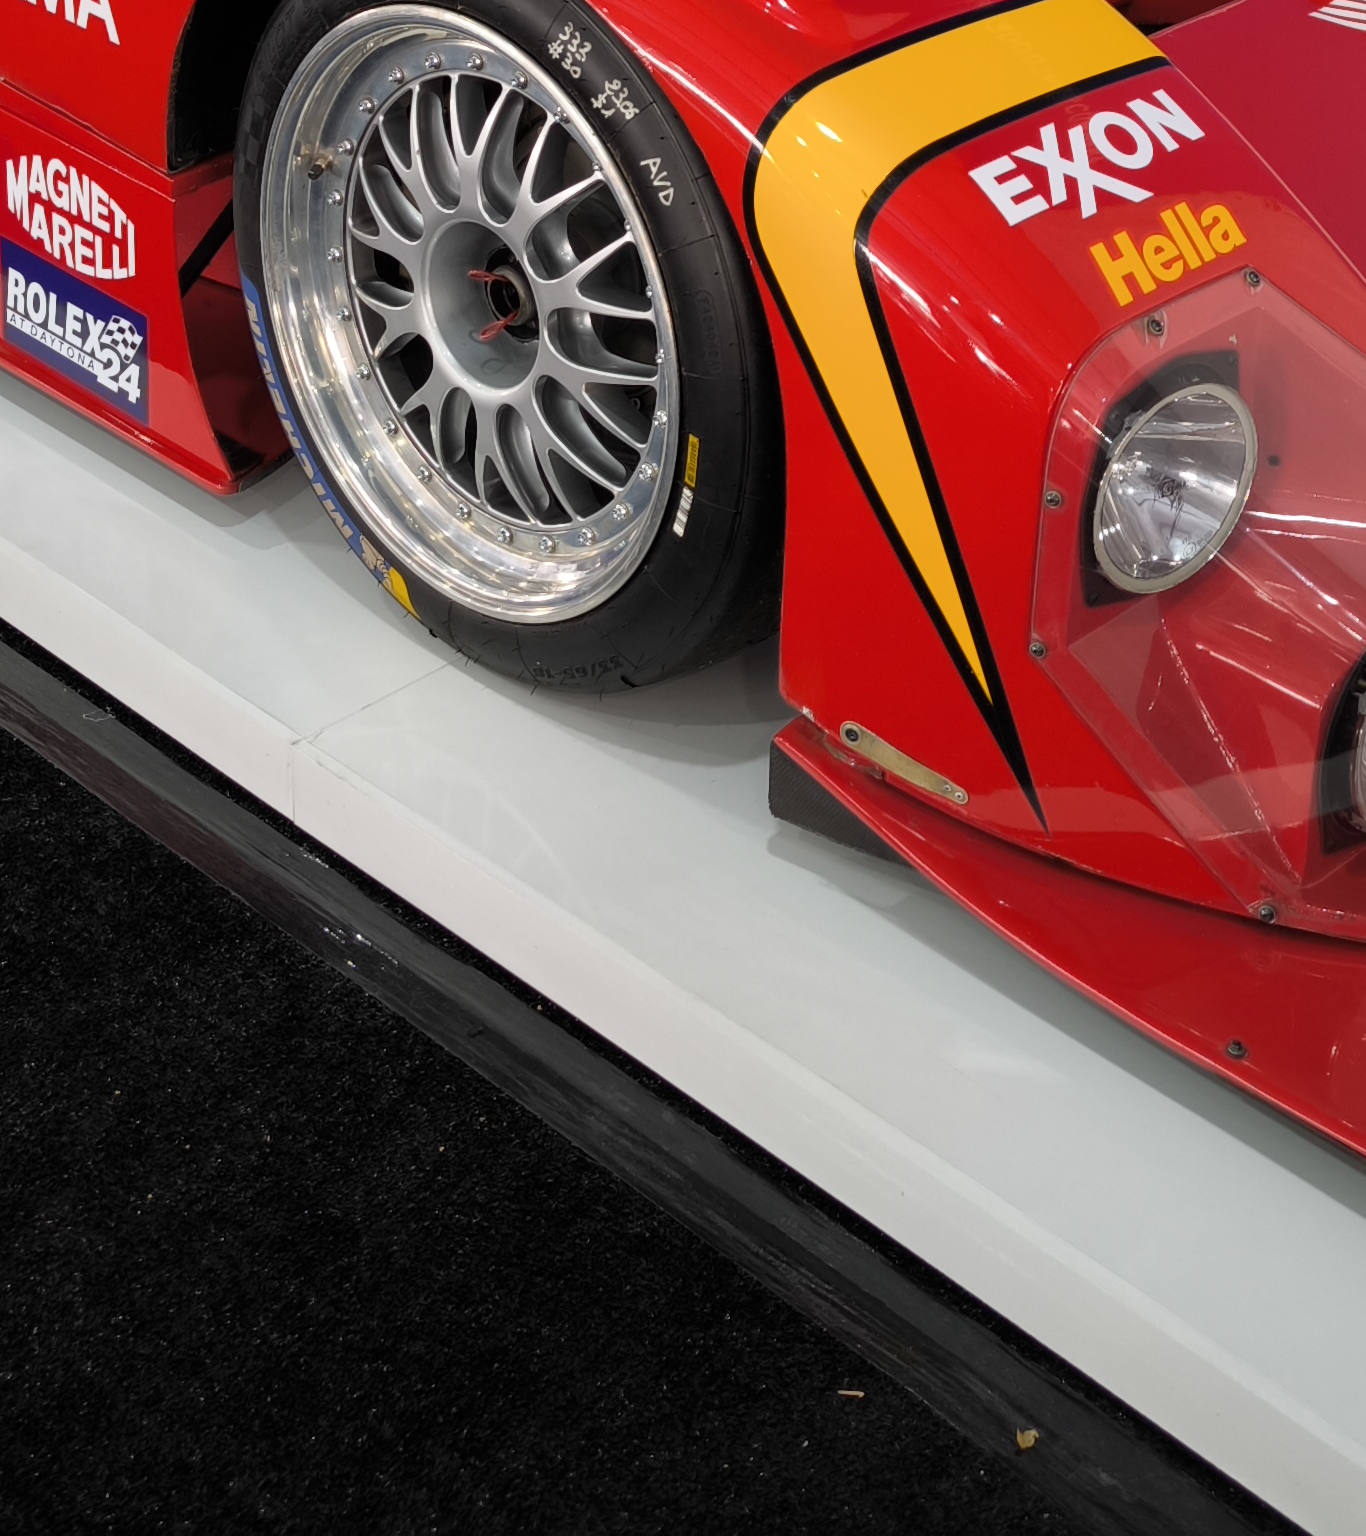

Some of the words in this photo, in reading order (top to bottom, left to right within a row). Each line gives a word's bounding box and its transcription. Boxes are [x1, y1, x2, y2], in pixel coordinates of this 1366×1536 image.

[6, 154, 135, 246] MAGNETI
[639, 156, 674, 206] AVD
[967, 88, 1206, 227] EXXON
[1089, 197, 1249, 309] Hella
[7, 266, 106, 355] ROLEX
[9, 314, 26, 330] AT
[30, 324, 95, 372] DAYTONA
[98, 347, 141, 405] 24
